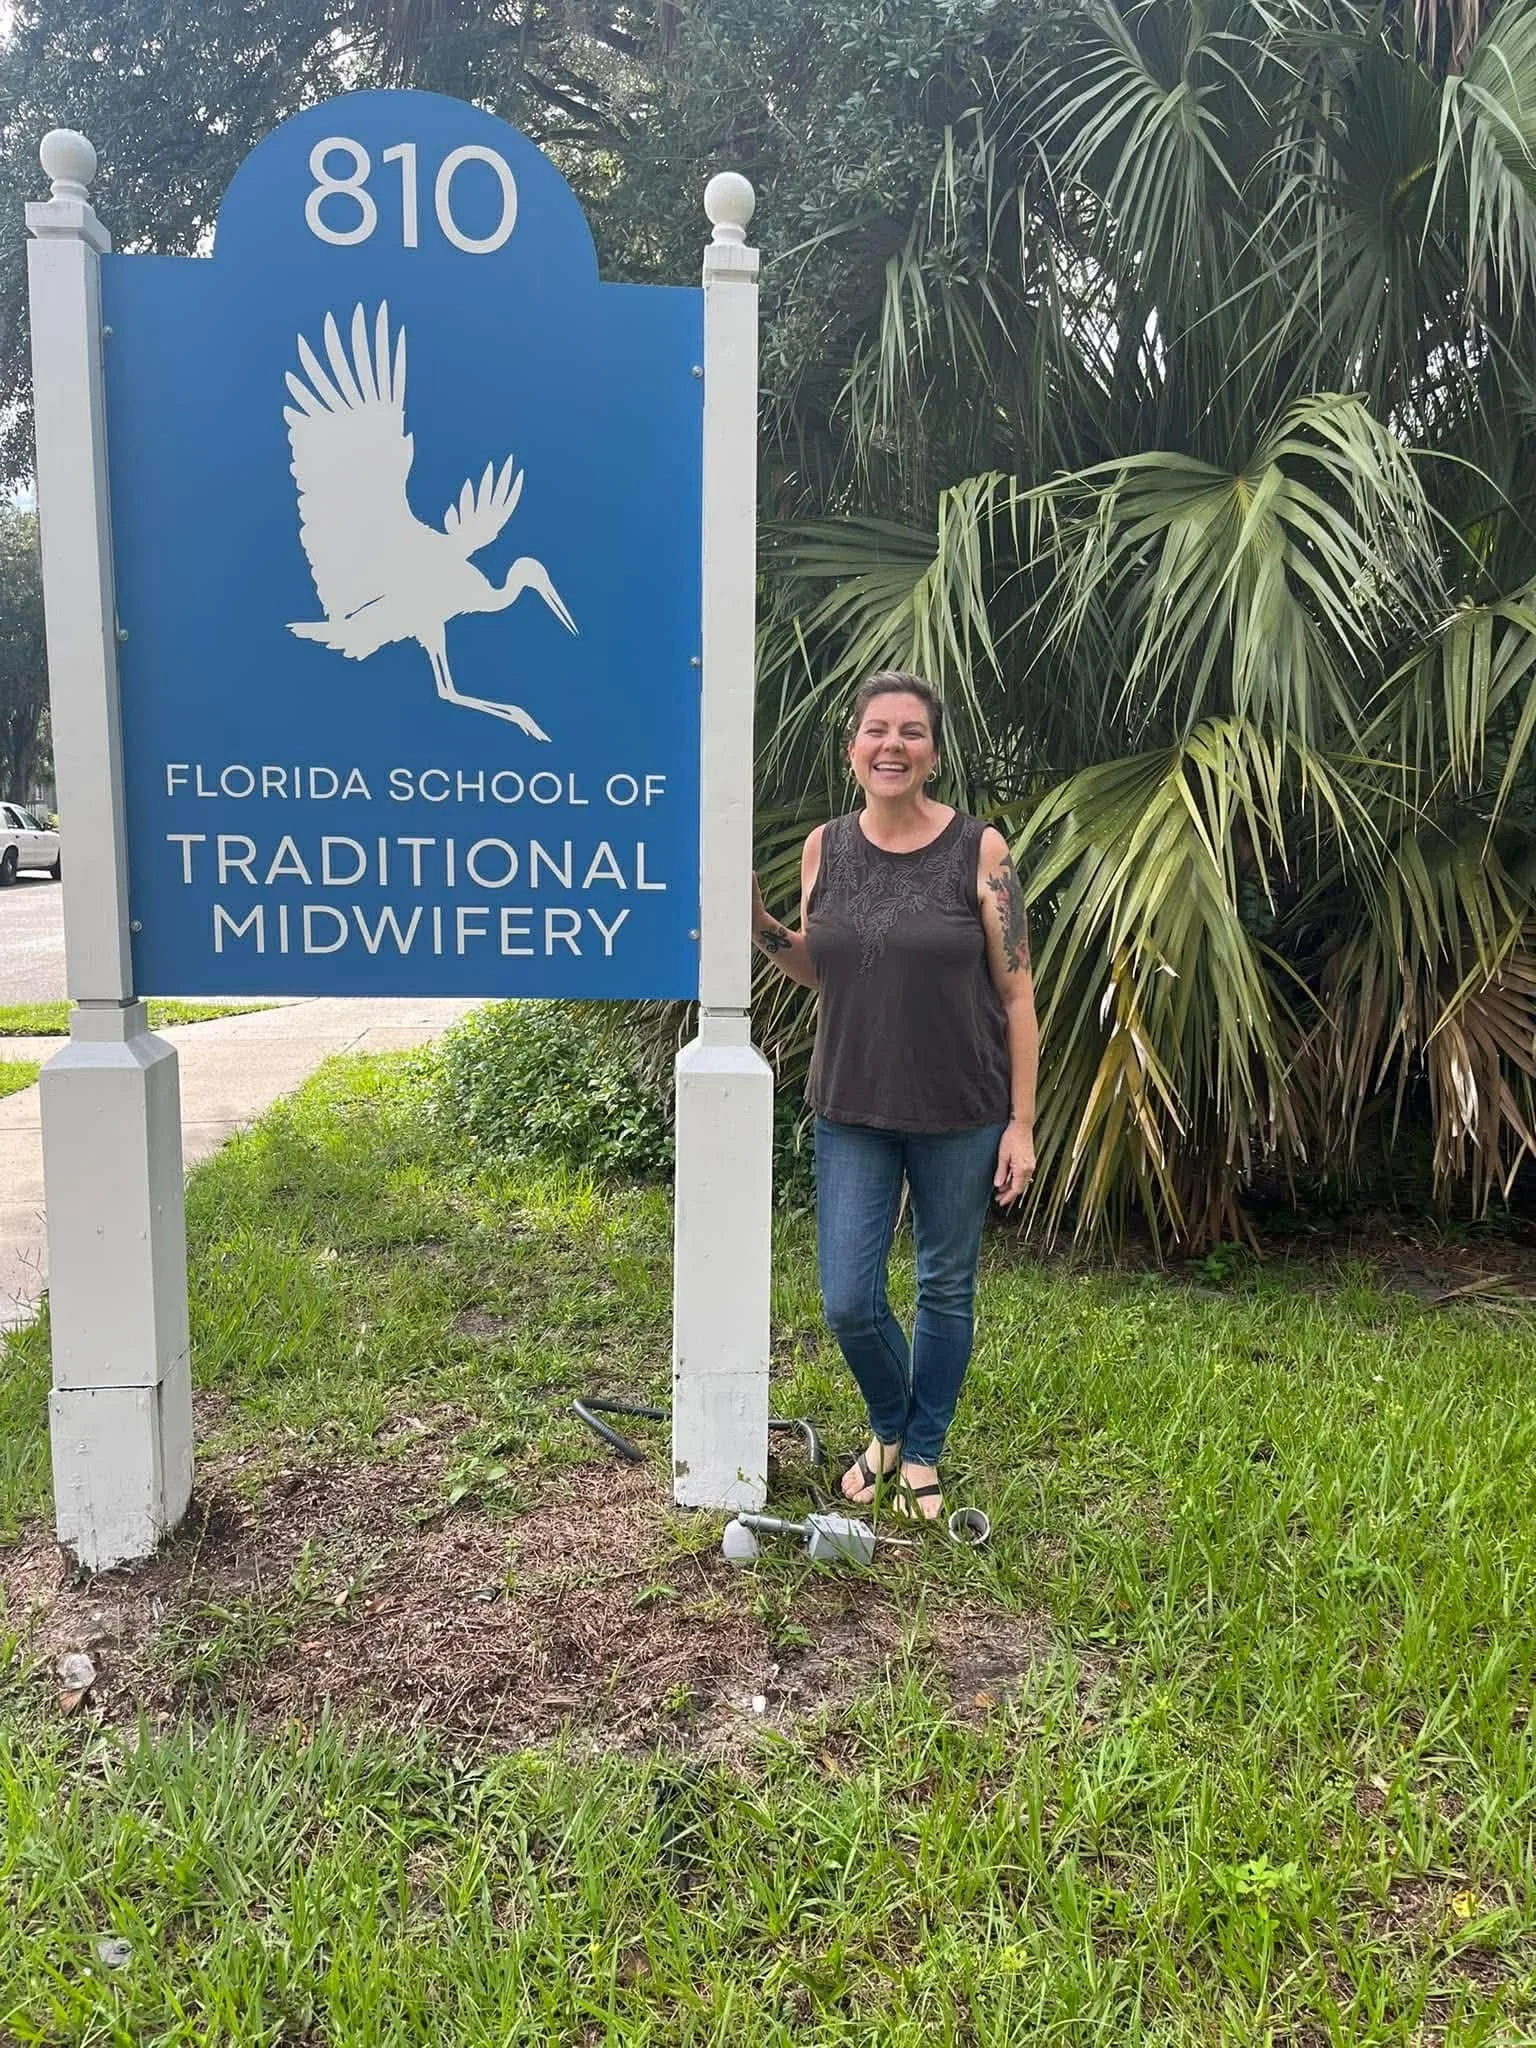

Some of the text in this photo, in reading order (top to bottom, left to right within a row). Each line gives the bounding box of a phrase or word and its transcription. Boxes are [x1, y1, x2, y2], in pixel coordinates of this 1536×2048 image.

[306, 137, 517, 253] 810
[168, 765, 665, 805] FLORIDA SCHOOL OF
[167, 835, 666, 889] TRADITIONAL
[214, 905, 629, 955] MIDWIFERY
